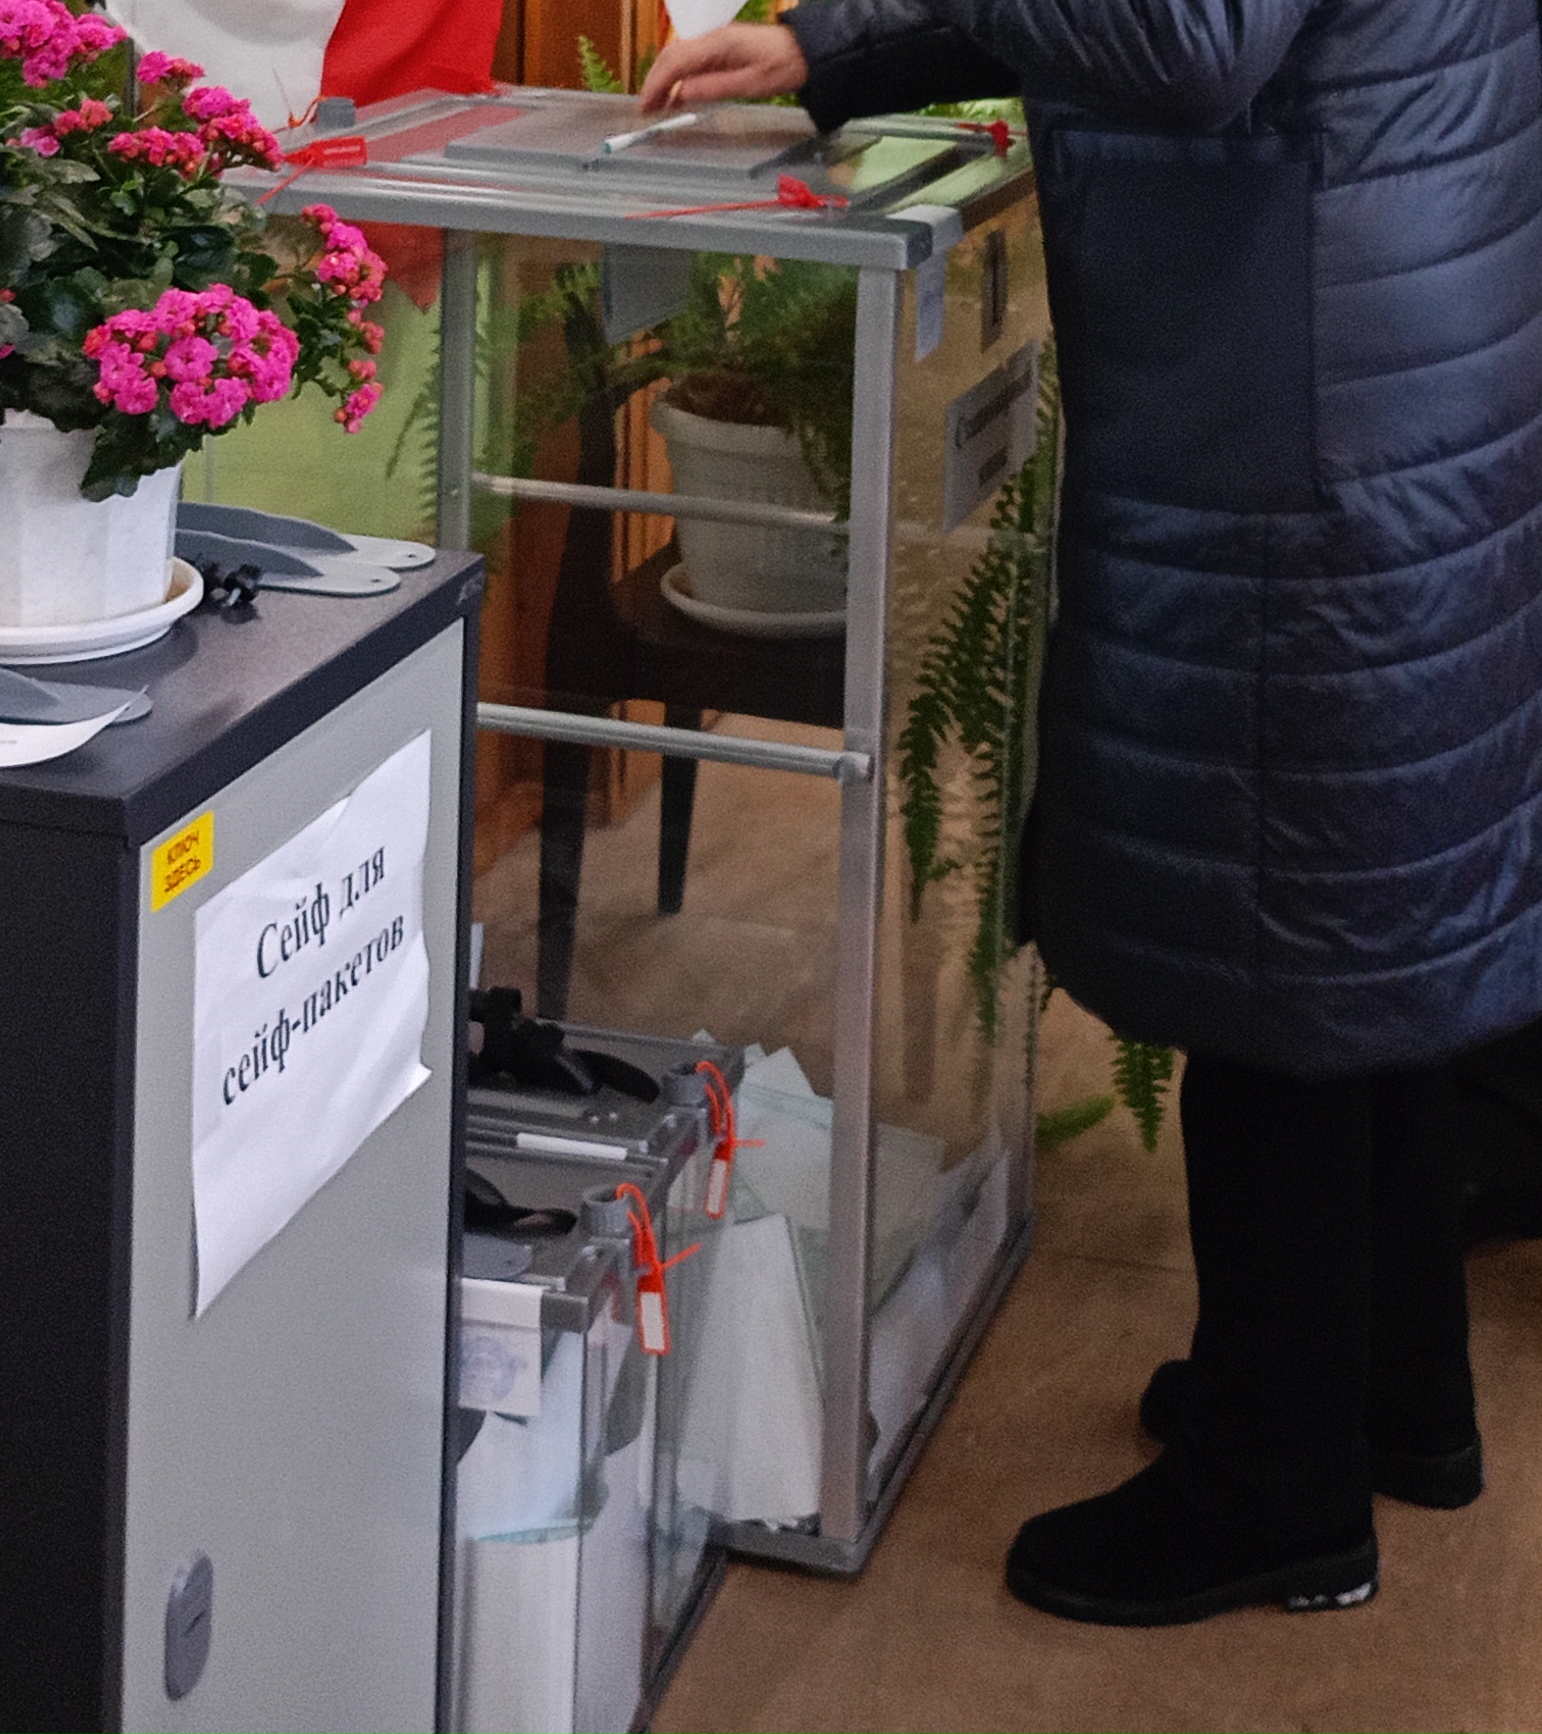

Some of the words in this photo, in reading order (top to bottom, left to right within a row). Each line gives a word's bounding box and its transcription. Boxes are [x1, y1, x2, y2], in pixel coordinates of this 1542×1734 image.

[164, 855, 202, 893] ЗДЕСЬ
[256, 882, 330, 979] Сейф
[339, 846, 386, 920] для
[223, 914, 405, 1106] сейф-пакетов
